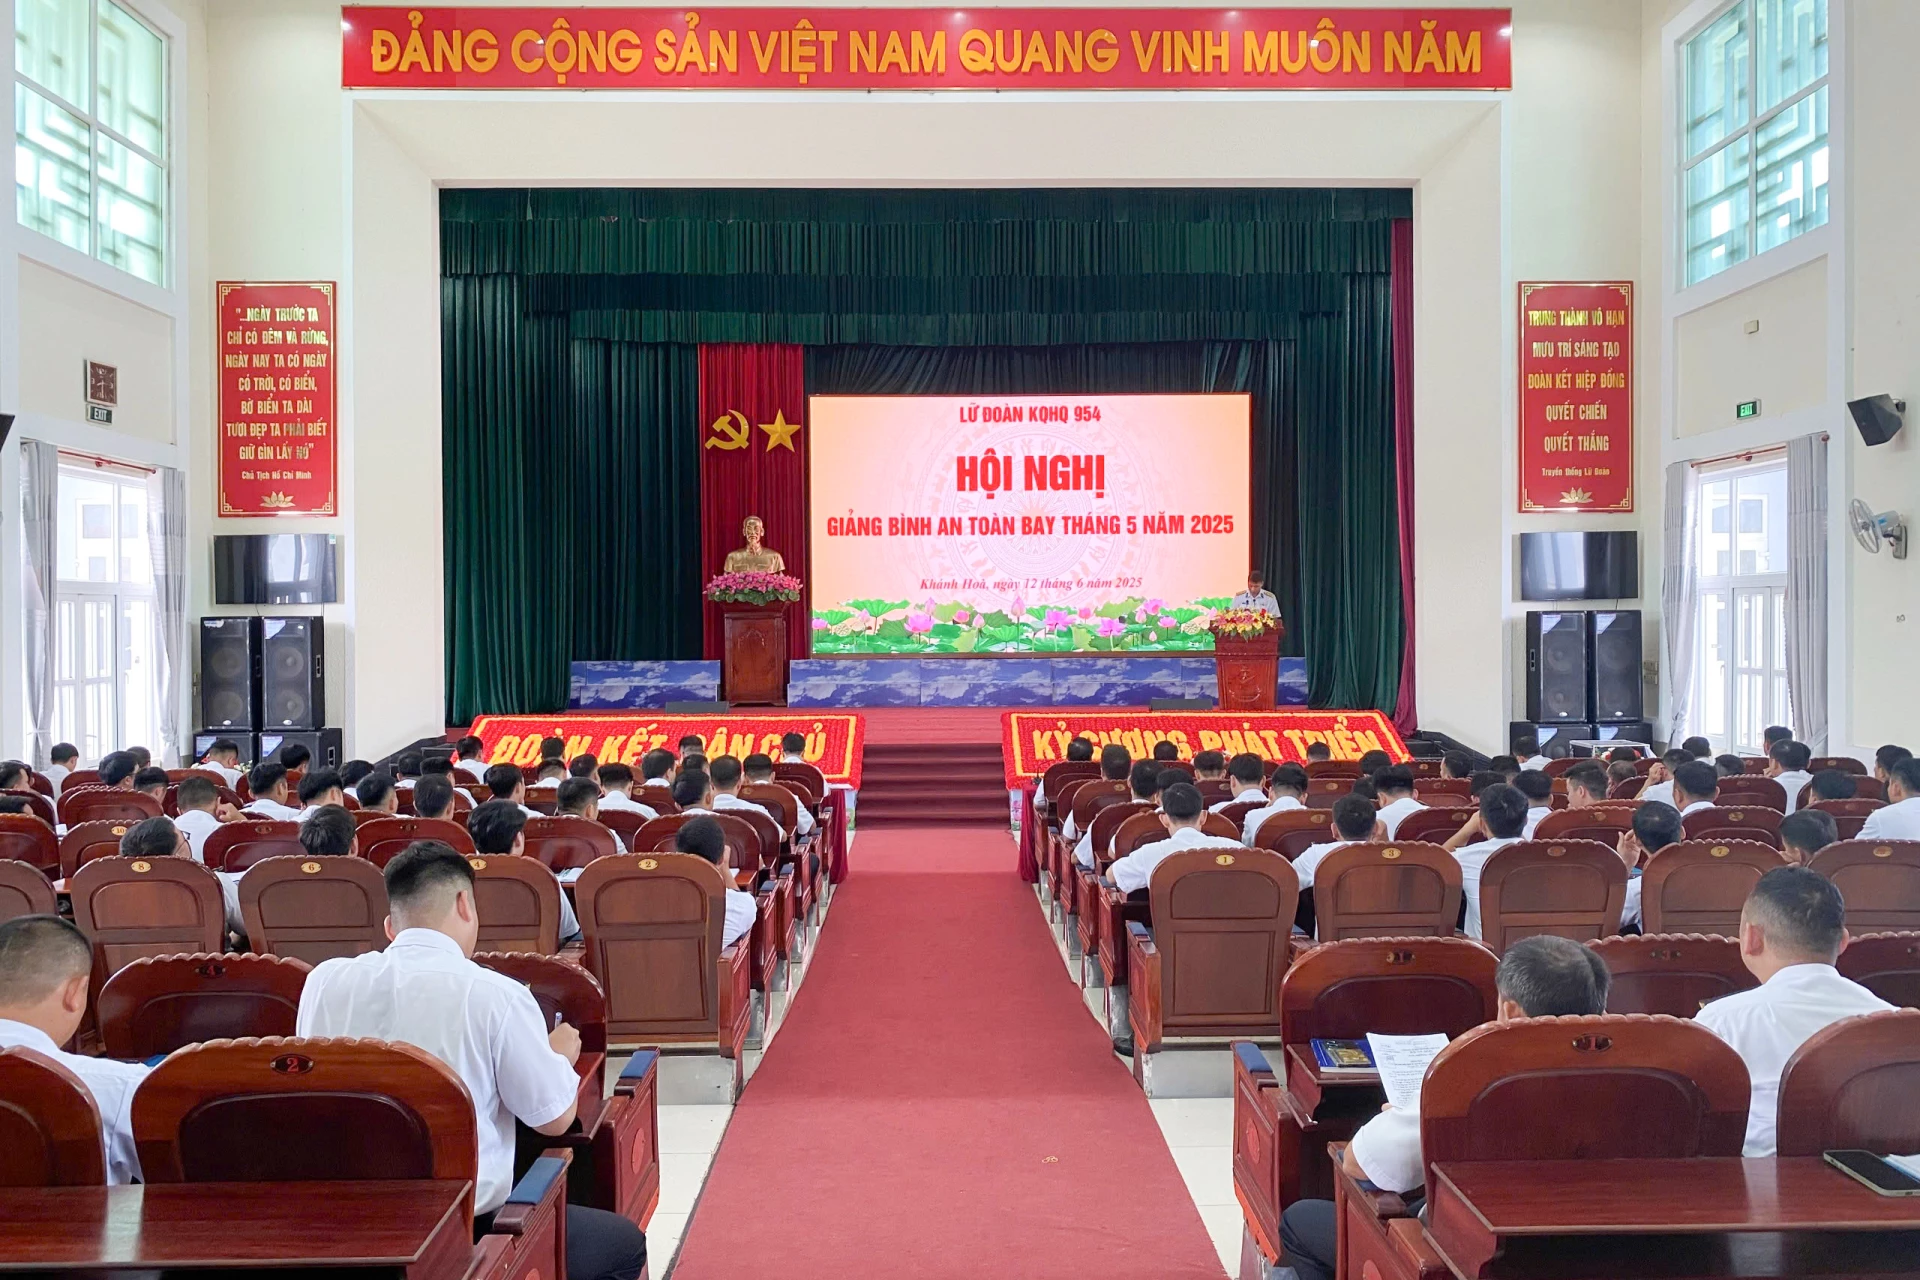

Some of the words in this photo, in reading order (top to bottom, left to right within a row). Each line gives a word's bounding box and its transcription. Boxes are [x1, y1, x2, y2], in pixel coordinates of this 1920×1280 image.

[371, 10, 499, 73] ĐẢNG
[511, 17, 643, 84] CỘNG
[654, 11, 738, 73] SẢN
[748, 18, 839, 84] VIỆT
[849, 30, 945, 73] NAM
[959, 28, 1119, 74] QUANG
[1131, 30, 1229, 73] VINH
[1244, 18, 1371, 73] MUÔN
[1384, 20, 1482, 73] NĂM
[275, 305, 305, 322] TRƯỚC
[307, 308, 318, 321] TA
[1528, 310, 1556, 326] TRUNG
[1560, 308, 1588, 326] THÀNH
[1592, 307, 1603, 325] VÔ
[1606, 310, 1624, 329] HẠN
[227, 326, 242, 344] CHỈ
[246, 328, 257, 344] CÓ
[262, 328, 282, 344] ĐÊM
[286, 328, 298, 344] VÀ
[1533, 340, 1554, 357] MƯU
[1558, 338, 1572, 357] TRÍ
[1574, 338, 1598, 357] SÁNG
[1603, 342, 1620, 360] TẠO
[226, 351, 249, 368] NGÀY
[253, 354, 270, 368] NAY
[274, 354, 285, 368] TA
[287, 351, 299, 368] CÓ
[303, 351, 327, 368] NGÀY
[239, 374, 250, 391] CÓ
[279, 374, 291, 391] CÓ
[1528, 370, 1552, 389] ĐOÀN
[1556, 368, 1572, 389] KẾT
[1576, 369, 1596, 391] HIỆP
[1600, 368, 1625, 389] ĐỒNG
[241, 396, 254, 415] BỜ
[258, 392, 278, 414] BIỂN
[283, 400, 294, 414] TA
[297, 397, 312, 414] DÀI
[1546, 400, 1575, 421] QUYẾT
[1579, 400, 1607, 420] CHIẾN
[1741, 403, 1752, 416] EXIT
[94, 408, 107, 420] EXIT
[959, 404, 980, 423] LỮ
[982, 404, 1023, 423] ĐOÀN
[1029, 407, 1069, 424] KQHQ
[1073, 407, 1102, 422] 954
[226, 422, 247, 437] TƯƠI
[250, 423, 267, 440] ĐẸP
[270, 423, 281, 437] TA
[283, 418, 305, 437] PHẢI
[308, 416, 327, 436] BIẾT
[239, 443, 255, 460] GIỮ
[258, 443, 273, 460] GÌN
[277, 440, 293, 460] LẤY
[1544, 430, 1573, 452] QUYẾT
[1578, 429, 1609, 451] THẮNG
[296, 470, 312, 480] Minh
[956, 448, 1012, 499] HỘI
[1024, 455, 1106, 499] NGHỊ
[827, 509, 883, 537] GIẢNG
[888, 514, 932, 536] BÌNH
[937, 517, 964, 535] AN
[969, 514, 1016, 535] TOÀN
[1021, 516, 1056, 534] BAY
[1062, 513, 1121, 534] THÁNG
[1126, 516, 1137, 534] 5
[1143, 514, 1185, 534] NĂM
[1191, 514, 1234, 534] 2025
[919, 576, 959, 591] Khánh
[993, 577, 1021, 593] ngày
[1024, 577, 1036, 589] 12
[1039, 577, 1074, 593] tháng
[1076, 577, 1084, 589] 6
[1086, 577, 1112, 589] năm
[1114, 576, 1142, 588] 2025
[488, 727, 594, 766] ĐON
[598, 723, 669, 765] KẾT
[760, 722, 827, 763] CỦ
[1032, 720, 1072, 760] KỶ
[1198, 722, 1284, 760] PHÁT
[1388, 848, 1394, 857] 3
[308, 863, 315, 871] 6
[286, 1058, 299, 1072] 2
